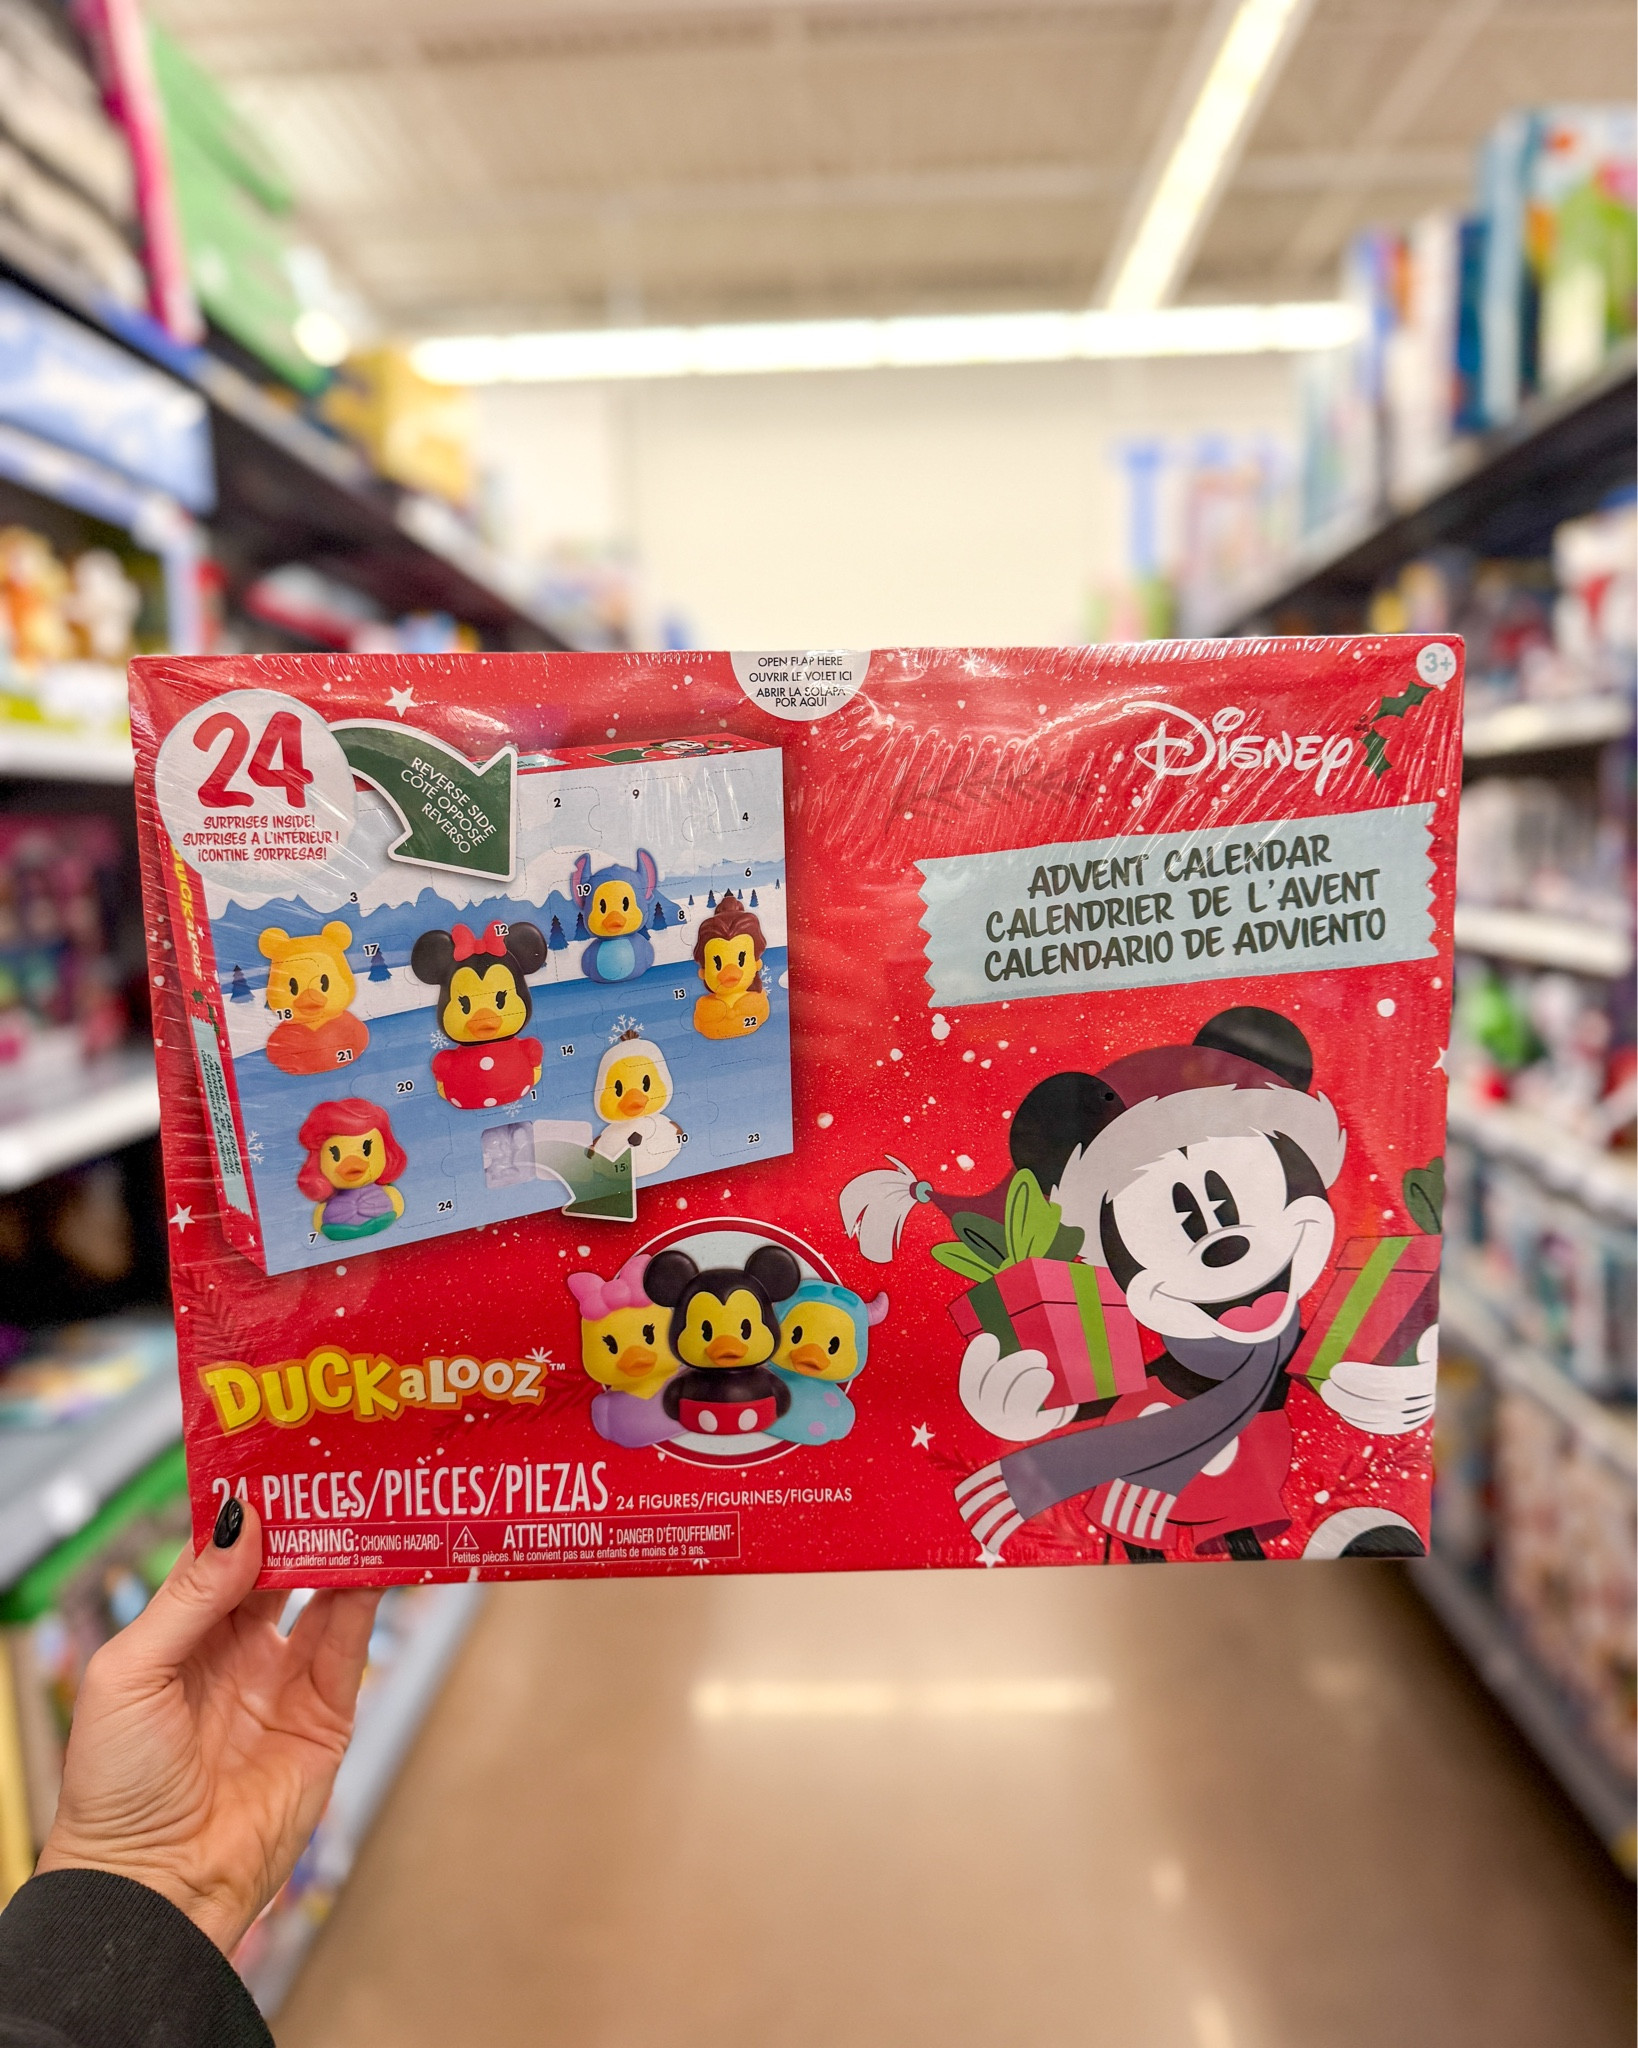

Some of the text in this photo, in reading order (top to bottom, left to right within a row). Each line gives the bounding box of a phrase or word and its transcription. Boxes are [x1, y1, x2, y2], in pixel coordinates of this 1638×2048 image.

[758, 656, 843, 667] OPEN FLAP HERE
[1424, 652, 1452, 674] 3+
[749, 671, 852, 682] OUVRIR LE VOLET ICI
[756, 686, 846, 697] ABRIR LA SOLAPA
[775, 697, 797, 707] POR
[193, 711, 314, 808] 24
[411, 757, 497, 837] REVERSE SIDE
[632, 789, 640, 799] 9
[401, 769, 486, 847] CÔTÉ OPPOSÉ
[553, 797, 562, 808] 2
[204, 815, 315, 829] SURPRISES INSIDE!
[741, 812, 749, 822] 4
[421, 803, 471, 853] REVERSO
[183, 832, 247, 846] SURPRISES
[264, 828, 333, 844] L'INTÉRIEUR
[198, 847, 327, 862] ¡CONTINE SORPRESAS!
[744, 866, 752, 877] 6
[1027, 834, 1332, 899] ADVENT CALENDAR
[577, 884, 591, 896] 19
[350, 891, 358, 902] 3
[986, 868, 1381, 943] CALENDRIER DE L'AVENT
[677, 909, 686, 920] 8
[495, 924, 509, 935] 12
[364, 944, 378, 956] 17
[984, 907, 1386, 982] CALENDARIO DE ADVIENTO
[673, 989, 686, 1000] 13
[277, 1009, 293, 1020] 18
[744, 1016, 757, 1027] 22
[337, 1050, 353, 1062] 21
[561, 1045, 574, 1056] 14
[397, 1080, 413, 1092] 20
[531, 1090, 537, 1100] 1
[676, 1133, 688, 1144] 10
[747, 1133, 760, 1143] 23
[614, 1163, 626, 1173] 15
[437, 1200, 452, 1212] 24
[310, 1233, 318, 1243] 7
[262, 1460, 609, 1520] PIECES/PIÈCES/PIEZAS
[616, 1495, 635, 1510] 24
[639, 1487, 853, 1510] FIGURES/FIGURINES/FIGURAS
[269, 1528, 359, 1554] WARNING:
[361, 1535, 402, 1551] CHOKING
[502, 1522, 603, 1549] ATTENTION
[616, 1528, 654, 1544] DANGER
[452, 1544, 706, 1565] Petites pièces. Ne convient pas aux enfants de moins de 3 ans.
[267, 1555, 385, 1568] Not for children under 3 years.
